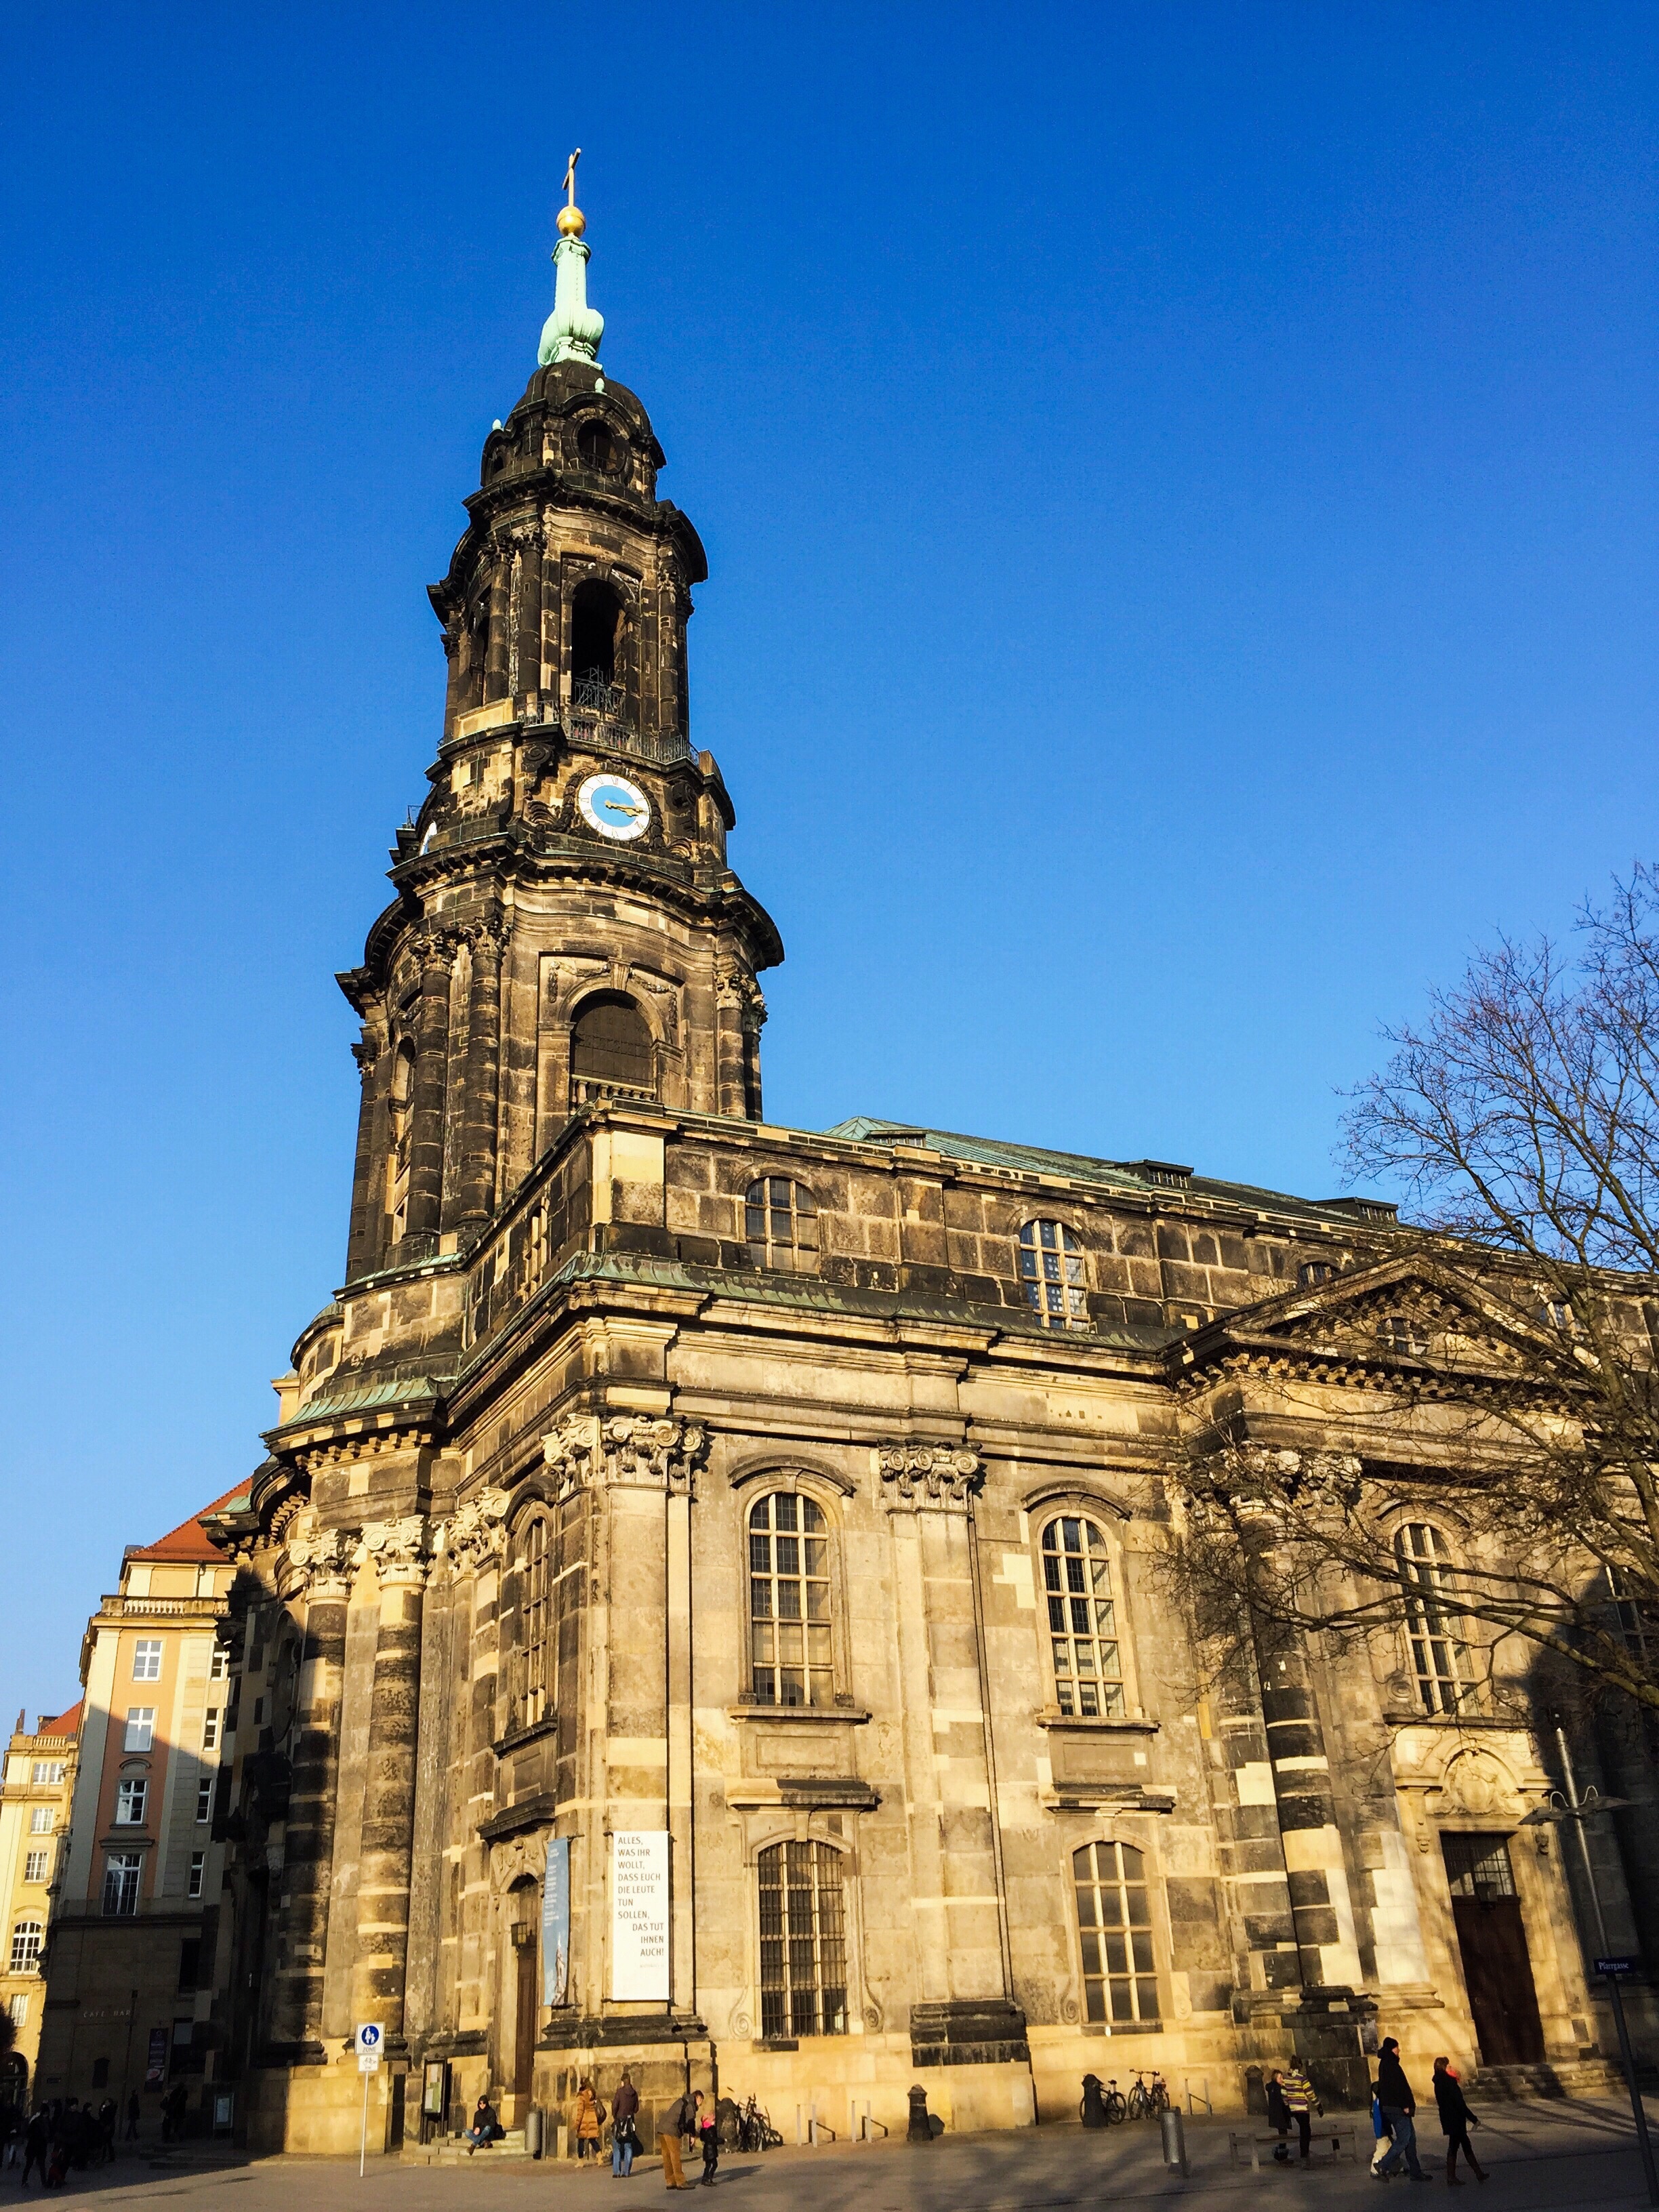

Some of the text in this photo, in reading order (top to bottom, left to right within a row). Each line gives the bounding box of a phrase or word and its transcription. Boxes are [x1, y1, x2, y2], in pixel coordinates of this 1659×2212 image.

[617, 1837, 643, 1845] ALLES,
[617, 1849, 651, 1857] WAS IHR
[617, 1861, 645, 1870] WOLLT,
[617, 1873, 661, 1881] DASS EUCH
[632, 1885, 655, 1893] LEUTE
[617, 1898, 634, 1906] TUN
[617, 1910, 650, 1920] SOLLEN,
[632, 1923, 663, 1931] DAS TUT
[640, 1936, 664, 1944] IHNEN
[640, 1948, 664, 1957] AUCH!
[1599, 1961, 1629, 1971] Pfarrgasse
